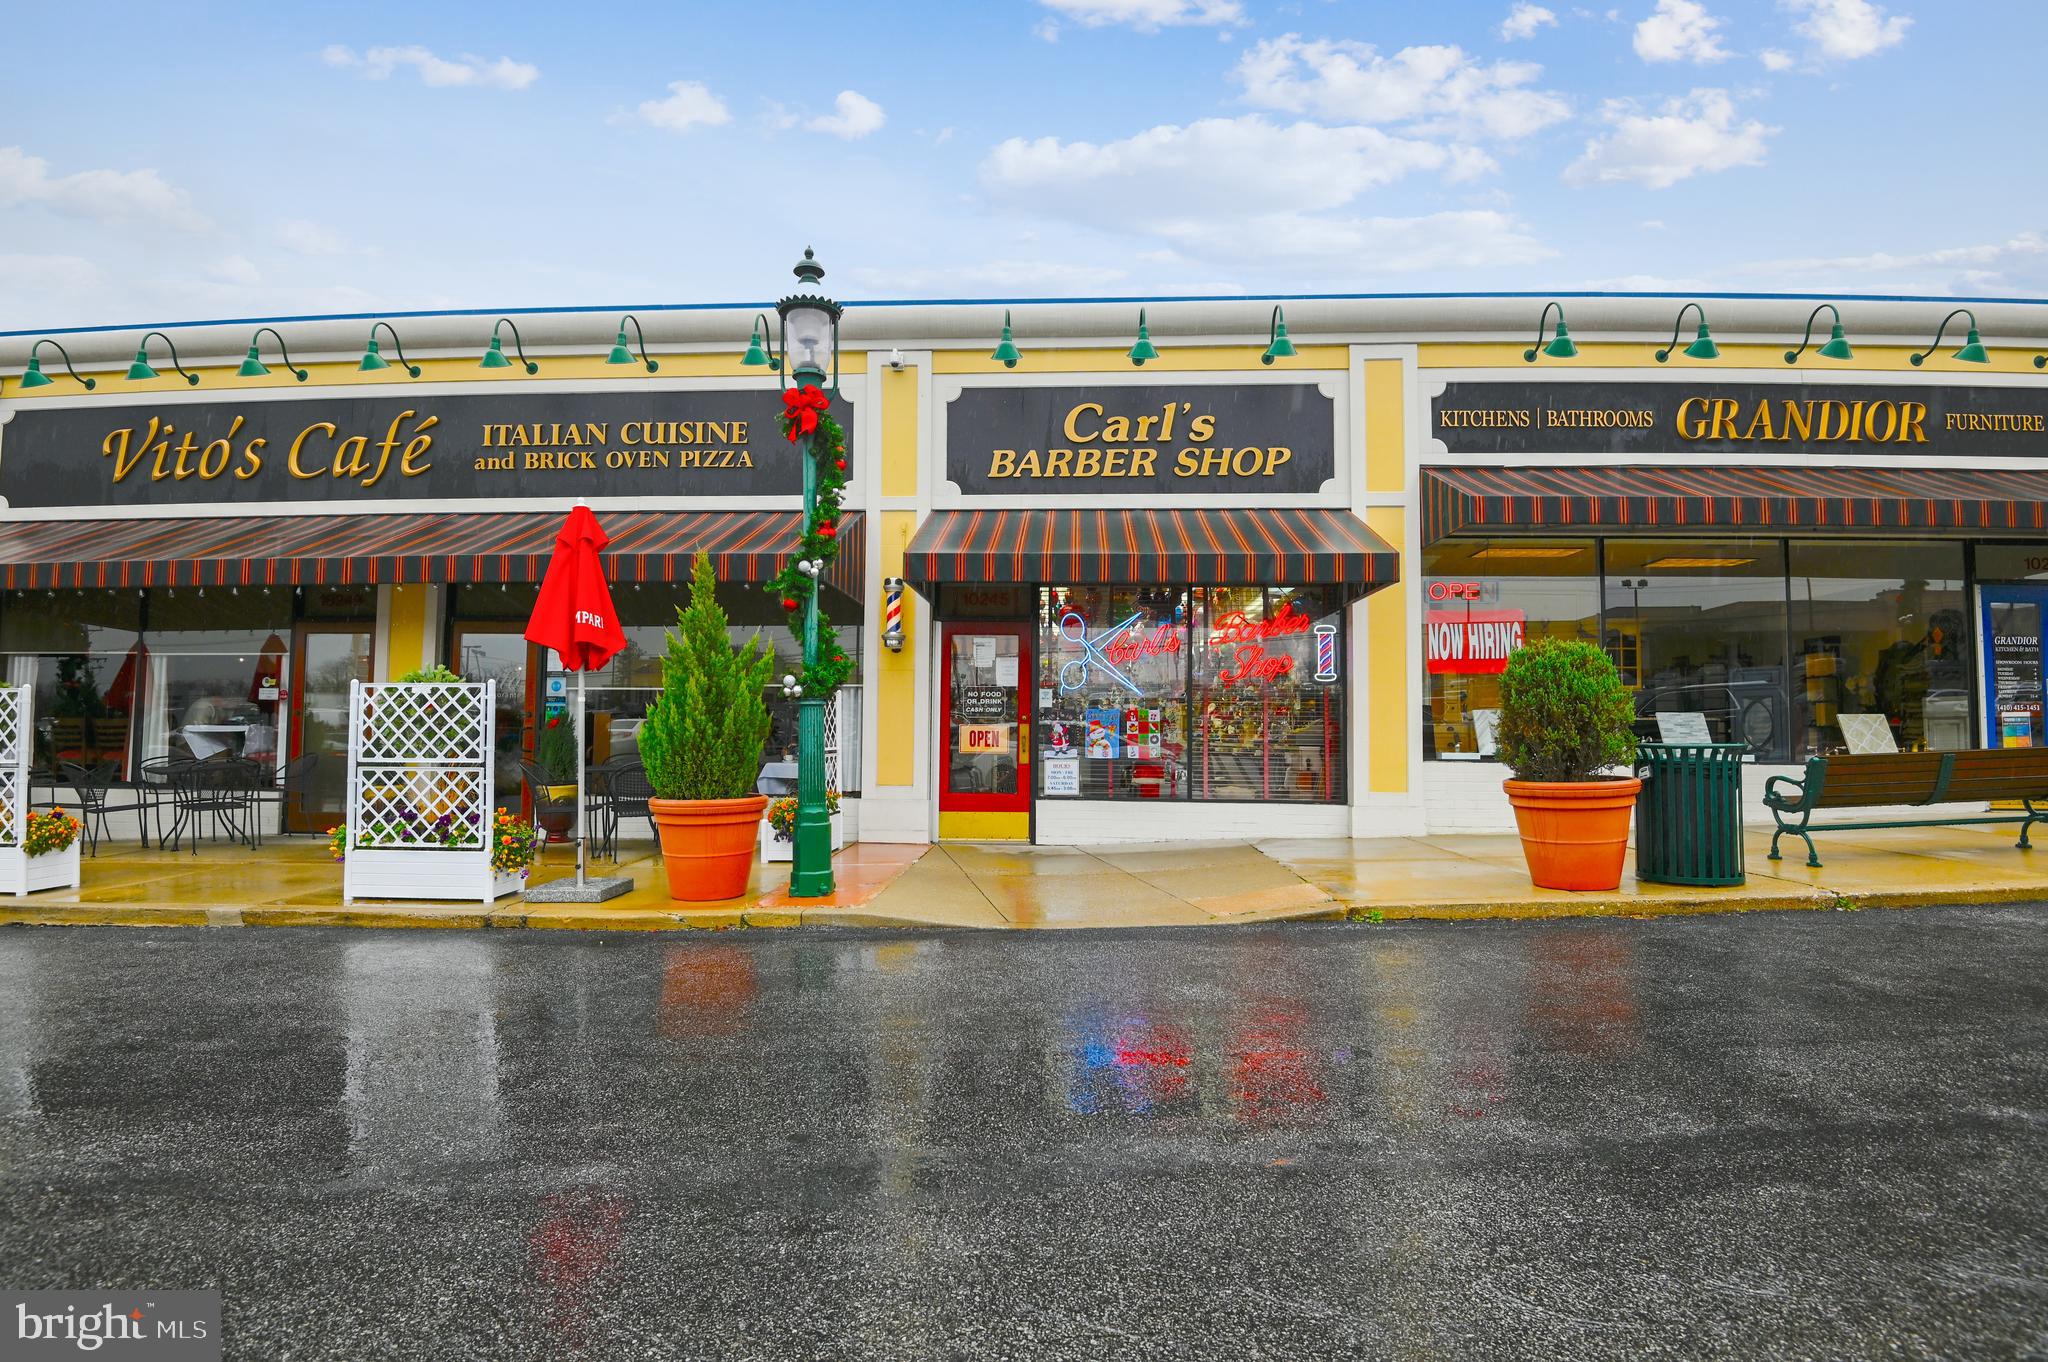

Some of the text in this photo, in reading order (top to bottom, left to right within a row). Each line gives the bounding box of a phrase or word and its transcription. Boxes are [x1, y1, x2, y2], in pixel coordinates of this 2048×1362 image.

[481, 421, 749, 447] ITALIAN CUISINE
[1063, 402, 1216, 443] Carl's
[1440, 409, 1530, 428] KITCHENS
[1546, 409, 1654, 428] BATHROOMS
[1675, 397, 1930, 443] GRANDIOR
[1945, 412, 2046, 432] FURNITURE
[288, 409, 440, 488] Café
[473, 449, 754, 470] and BRICK OVEN PIZZA
[987, 447, 1292, 478] BARBER SHOP
[1208, 602, 1311, 647] Barber
[1428, 621, 1523, 660] NOW HIRING
[1994, 636, 2038, 645] GRANDIOR
[1106, 624, 1181, 665] Carl's
[1219, 644, 1295, 682] Shop
[969, 730, 1000, 748] OPEN
